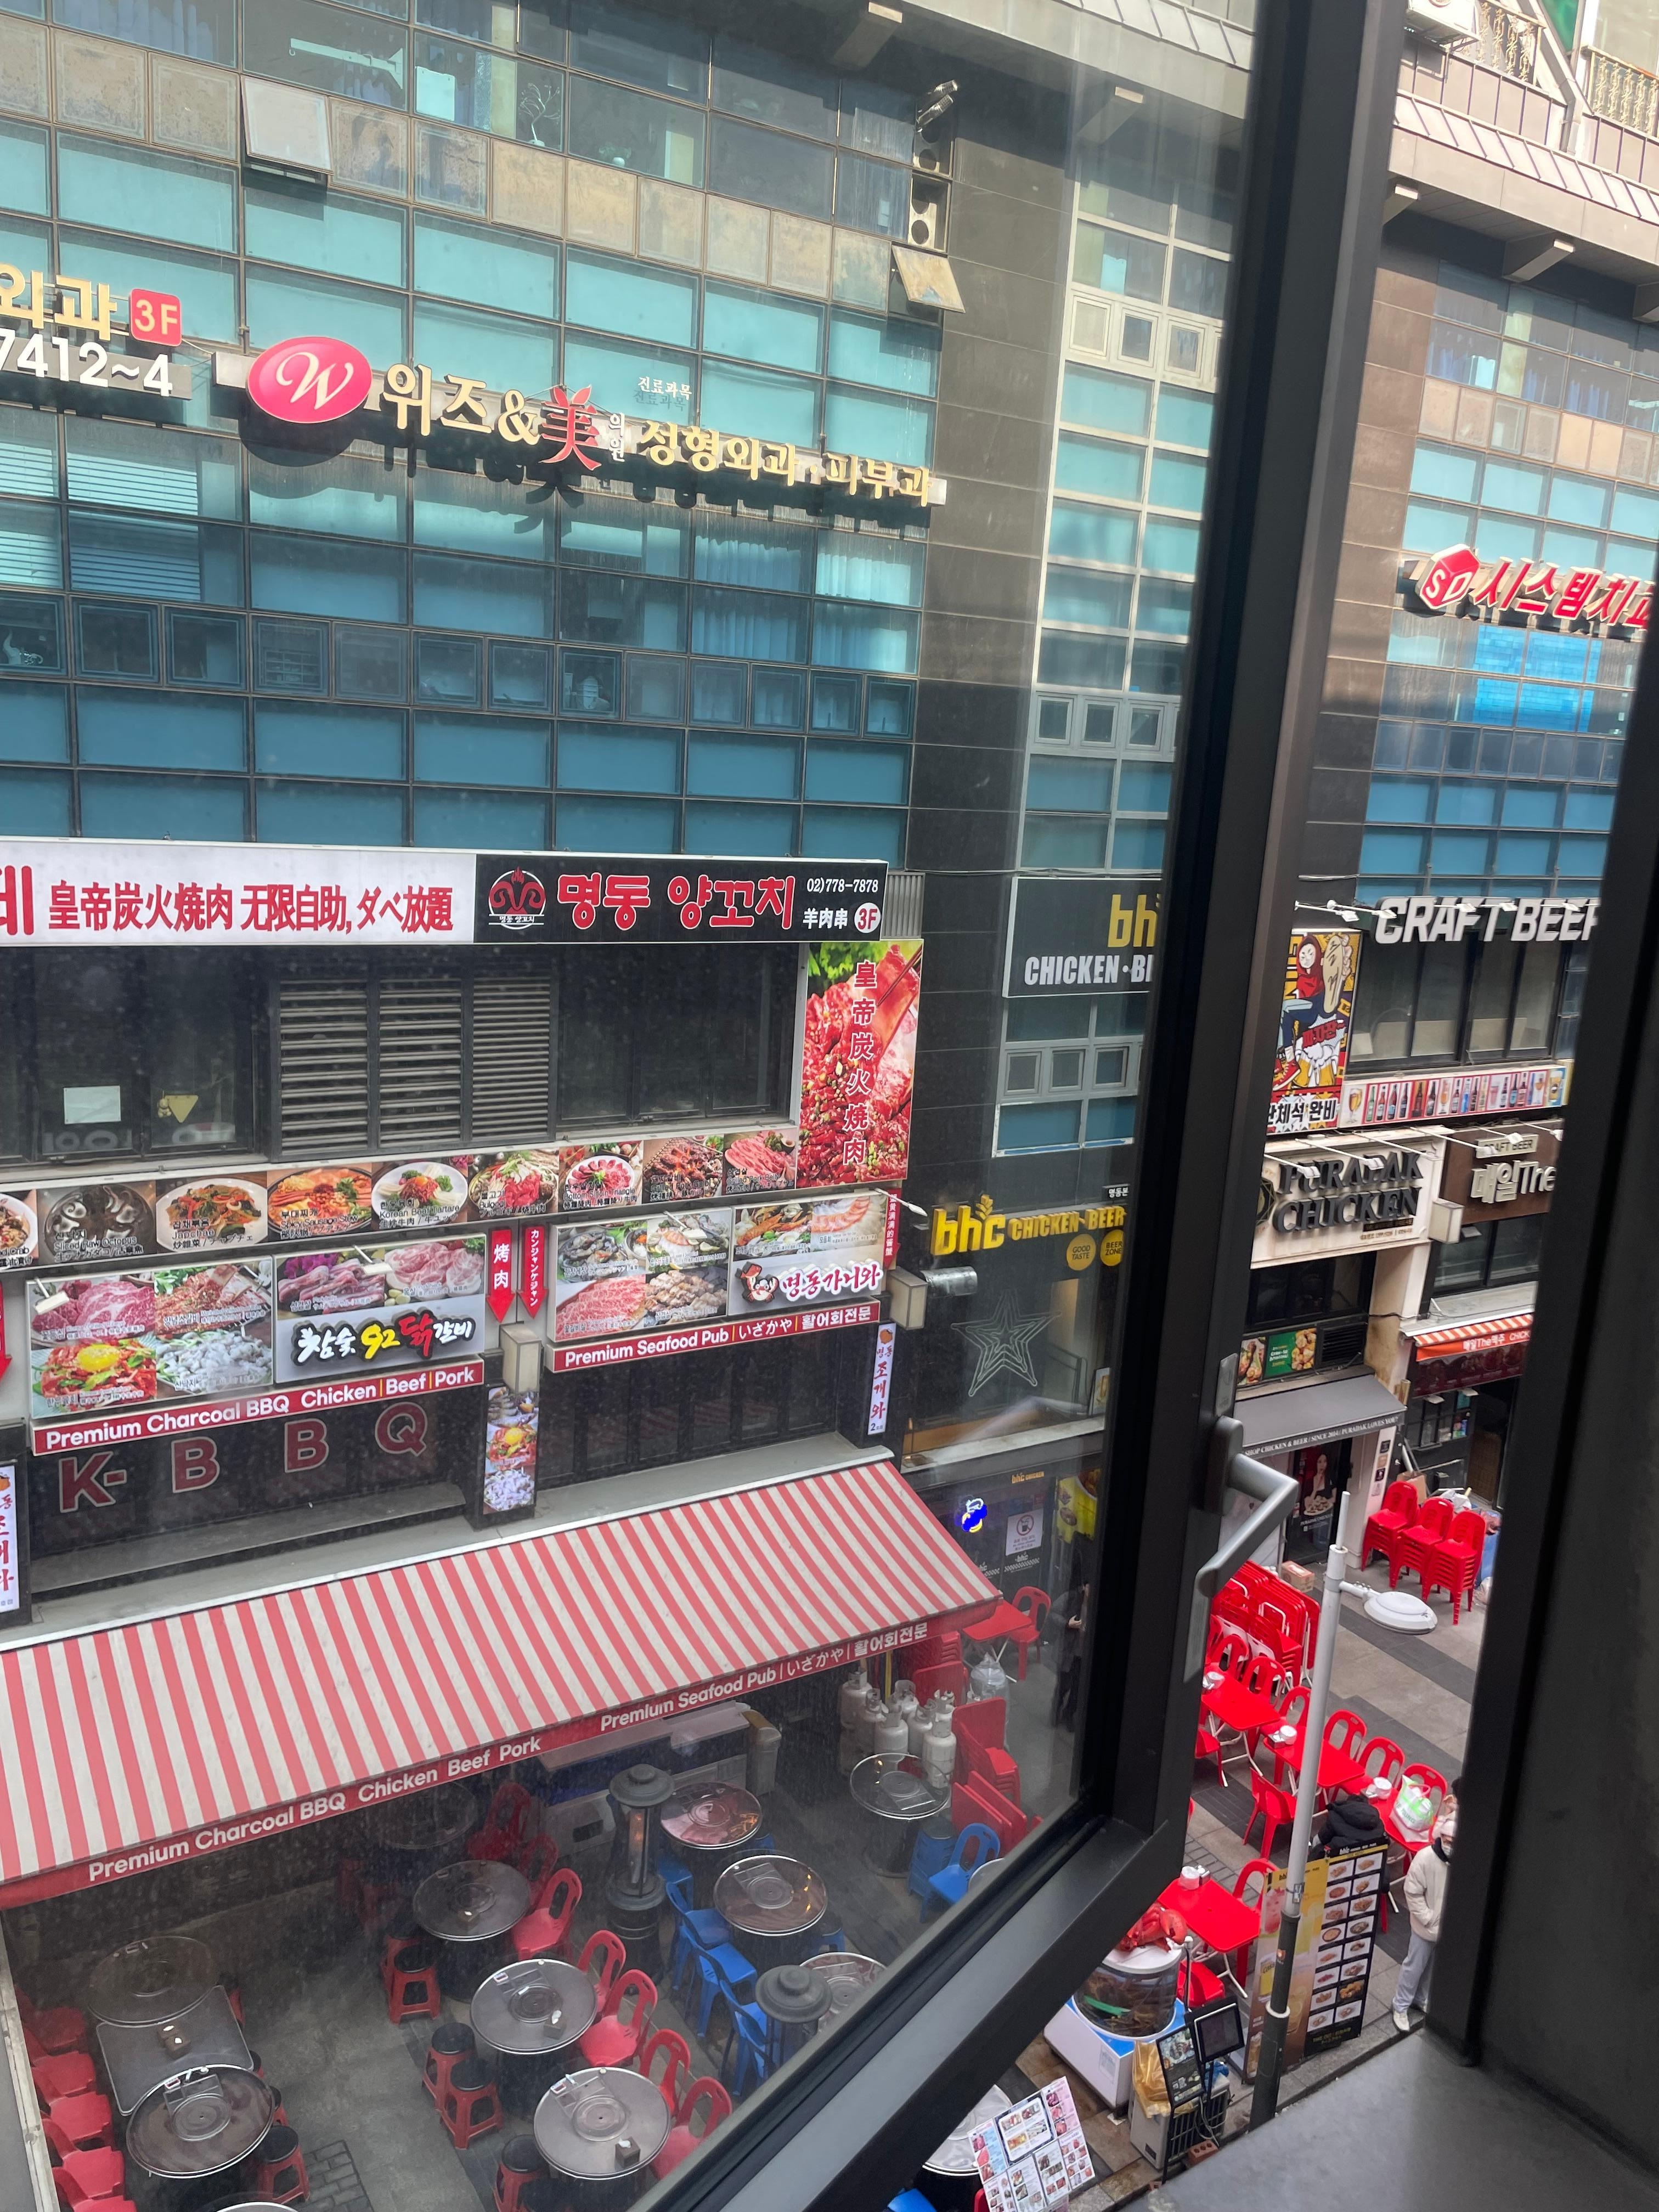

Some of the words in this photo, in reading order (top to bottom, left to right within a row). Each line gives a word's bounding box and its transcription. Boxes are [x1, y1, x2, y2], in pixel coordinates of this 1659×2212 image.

[0, 263, 117, 341] 외과
[134, 299, 177, 335] 3F
[638, 376, 692, 400] 진료과목
[1425, 568, 1474, 602] SD
[557, 872, 651, 930] 명동
[667, 874, 797, 930] 양꼬치
[806, 878, 878, 893] 02)778-7878
[803, 907, 848, 929] 羊肉串
[857, 908, 877, 930] 3F
[1375, 896, 1502, 944] CRAFT
[1309, 1099, 1337, 1121] 완비
[930, 1204, 1006, 1256] bhc
[1007, 1211, 1080, 1241] CHICKEN
[1085, 1206, 1125, 1230] BEER
[1273, 1187, 1423, 1233] CHICKEN
[101, 1237, 137, 1247] Octopus
[1105, 1248, 1122, 1256] ZONE
[493, 1243, 510, 1290] 烤肉
[530, 1229, 539, 1307] カンジャンケジャン
[565, 1345, 633, 1367] Premium
[637, 1331, 698, 1356] Seafood
[702, 1328, 729, 1345] Pub
[738, 1318, 793, 1340] いざかや
[802, 1306, 871, 1329] 활어회전문
[46, 1420, 141, 1450] Premium
[146, 1402, 241, 1432] Charcoal
[246, 1395, 290, 1419] BBQ
[301, 1384, 376, 1408] Chicken
[386, 1373, 427, 1395] Beef
[435, 1367, 475, 1387] Pork
[871, 1361, 888, 1419] 조개와
[1261, 1442, 1286, 1453] CHICKEN
[1293, 1437, 1308, 1446] BEER
[1311, 1434, 1328, 1442] SINCE
[601, 1700, 674, 1732] Premium
[678, 1678, 744, 1709] Seafood
[747, 1666, 777, 1689] Pub
[787, 1649, 843, 1677] いざかや
[854, 1622, 929, 1658] 활어회전문
[89, 1839, 190, 1882] Premium
[195, 1810, 294, 1852] Charcoal
[300, 1793, 346, 1821] BBQ
[358, 1769, 437, 1803] Chicken
[447, 1750, 491, 1778] Beef
[499, 1735, 541, 1763] Pork
